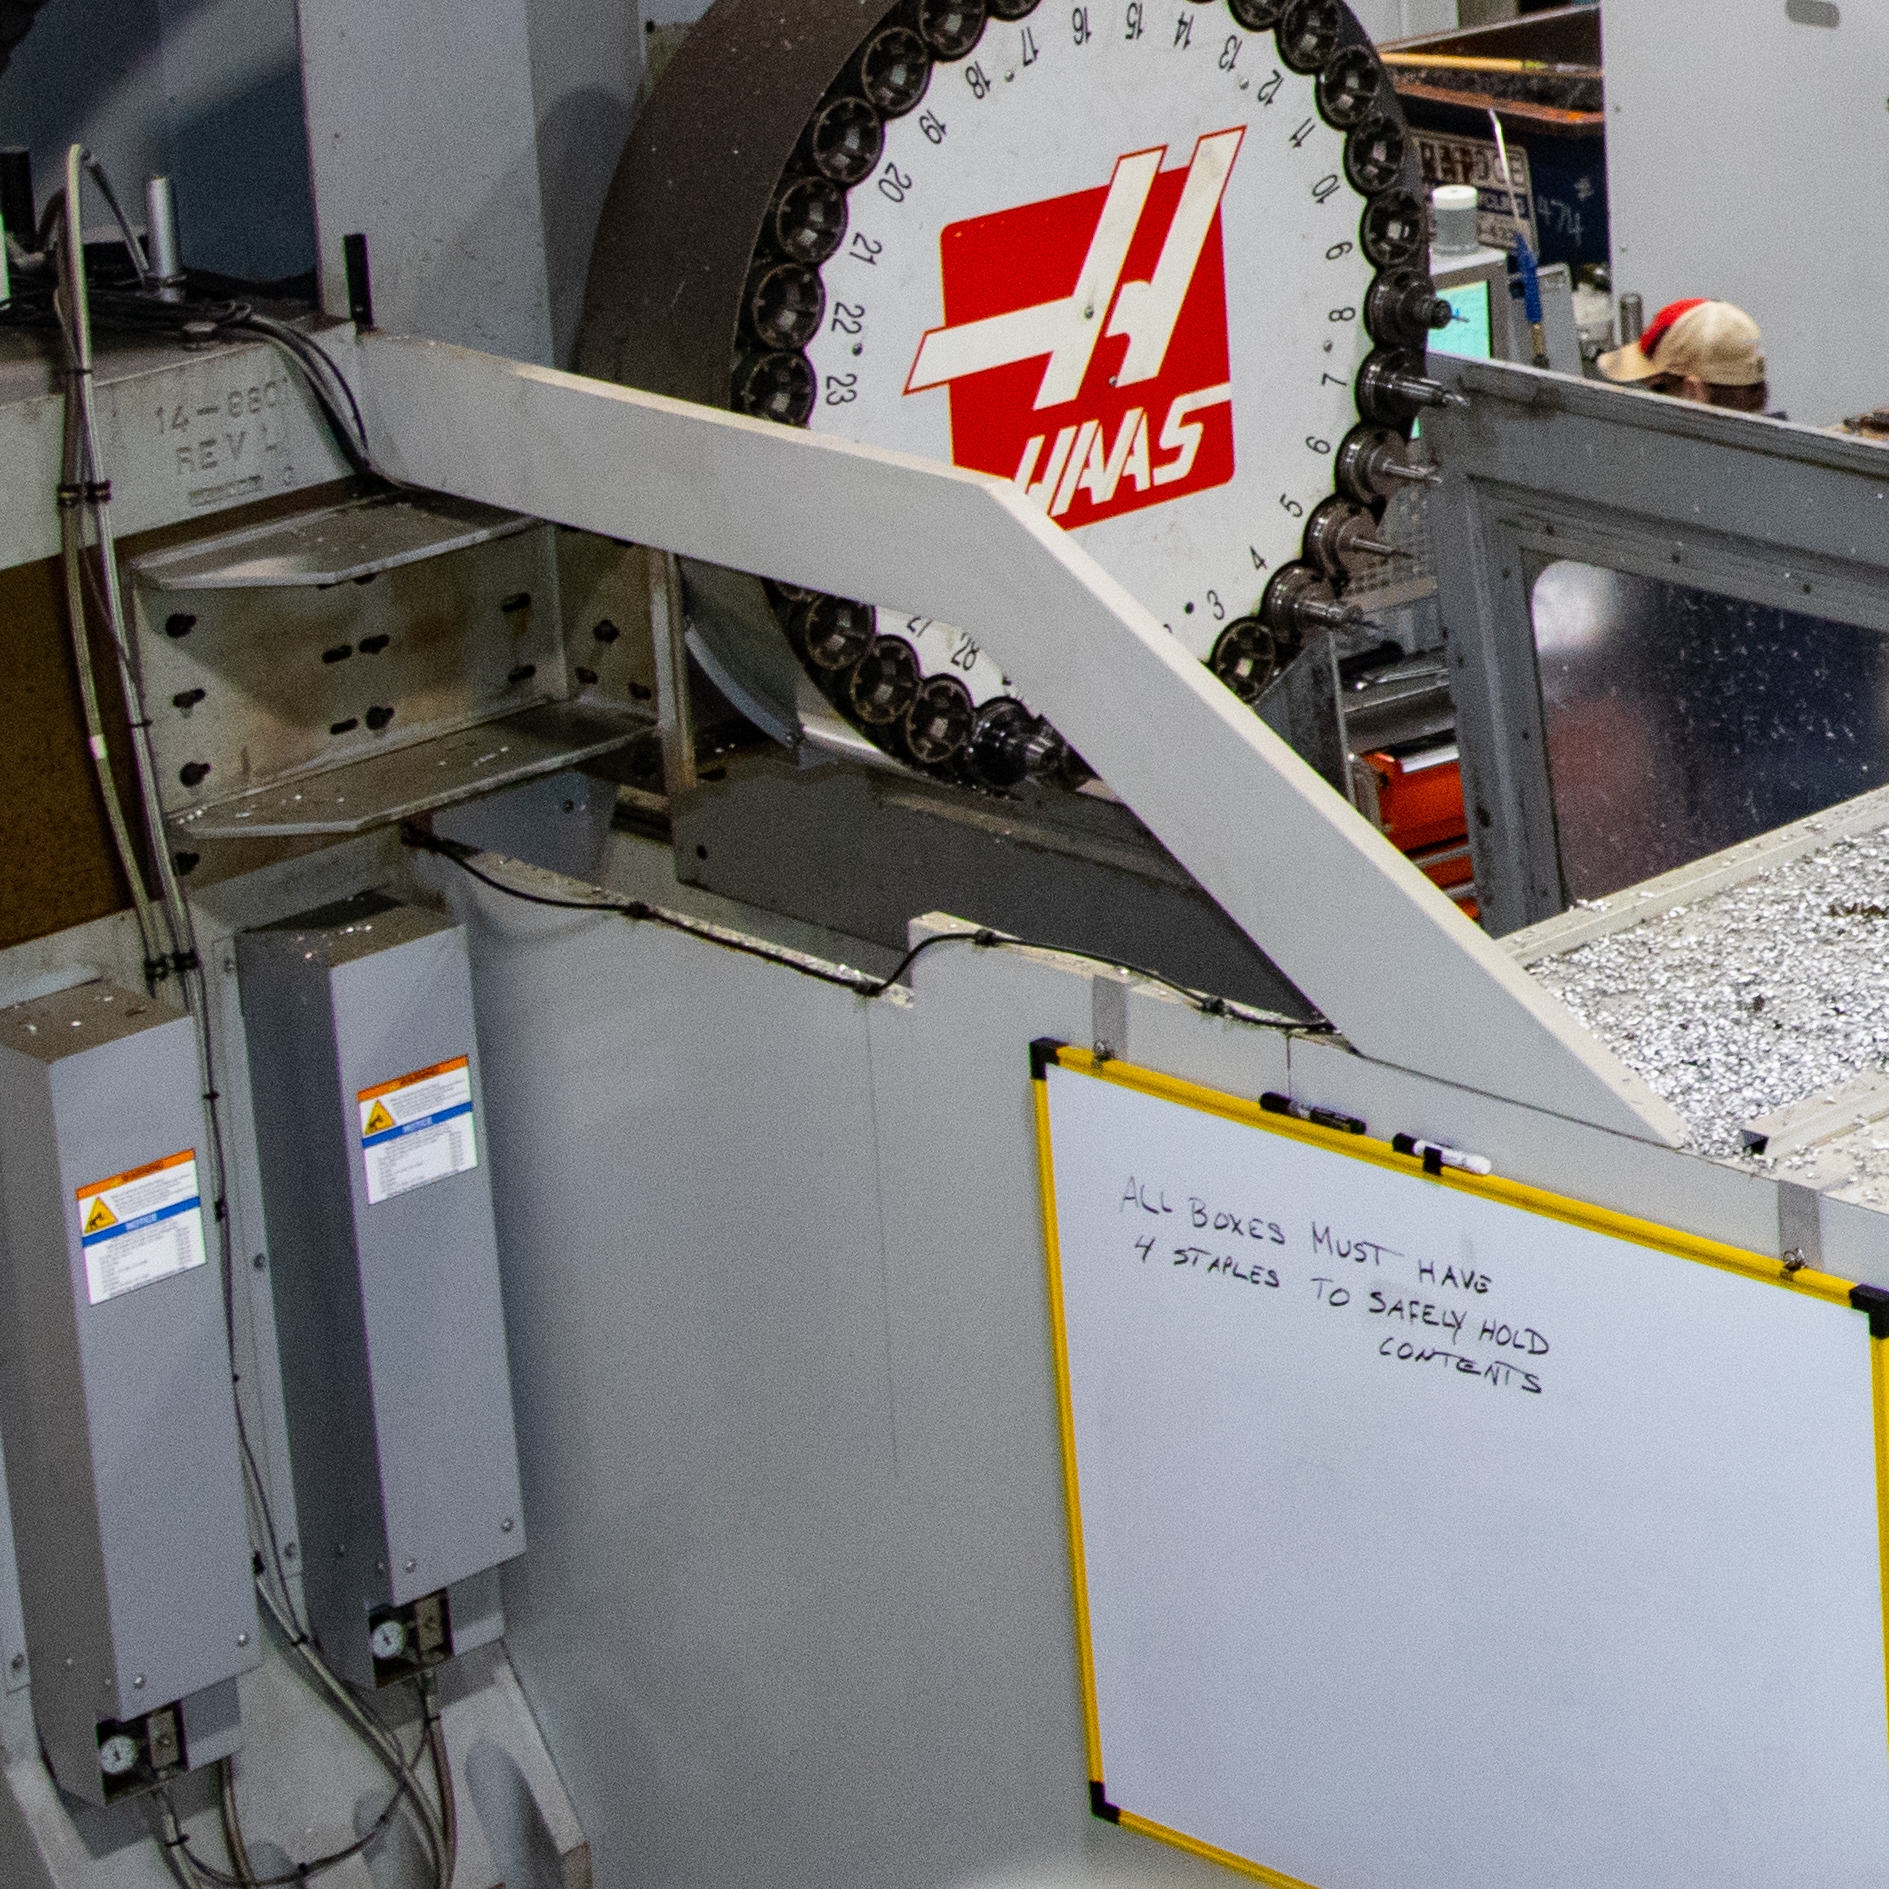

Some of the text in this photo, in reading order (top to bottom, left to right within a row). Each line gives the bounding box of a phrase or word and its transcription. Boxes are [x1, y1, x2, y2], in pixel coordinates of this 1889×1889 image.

[1072, 7, 1092, 46] 16
[1124, 2, 1144, 41] 15
[1173, 12, 1194, 50] 14
[1021, 27, 1040, 68] 17
[1218, 34, 1243, 72] 13
[964, 60, 992, 100] 18
[1256, 68, 1284, 107] 12
[918, 109, 947, 146] 19
[1289, 117, 1316, 149] 11
[877, 161, 913, 204] 20
[1311, 173, 1340, 205] 10
[848, 231, 883, 266] 21
[1325, 240, 1354, 261] 9
[830, 301, 866, 335] 22
[1328, 306, 1356, 323] 8
[825, 373, 858, 406] 23
[1320, 372, 1348, 388] 7
[1013, 380, 1232, 518] HAAS
[1305, 435, 1332, 455] 6
[1279, 493, 1304, 518] 5
[1249, 546, 1268, 571] 4
[1206, 589, 1225, 621] 3
[1119, 1175, 1492, 1295] ALL BOXES MUST HAVE
[1134, 1235, 1551, 1356] 4 STAPLES TO SAFELY HOLD
[1379, 1336, 1543, 1395] CONTENTS
